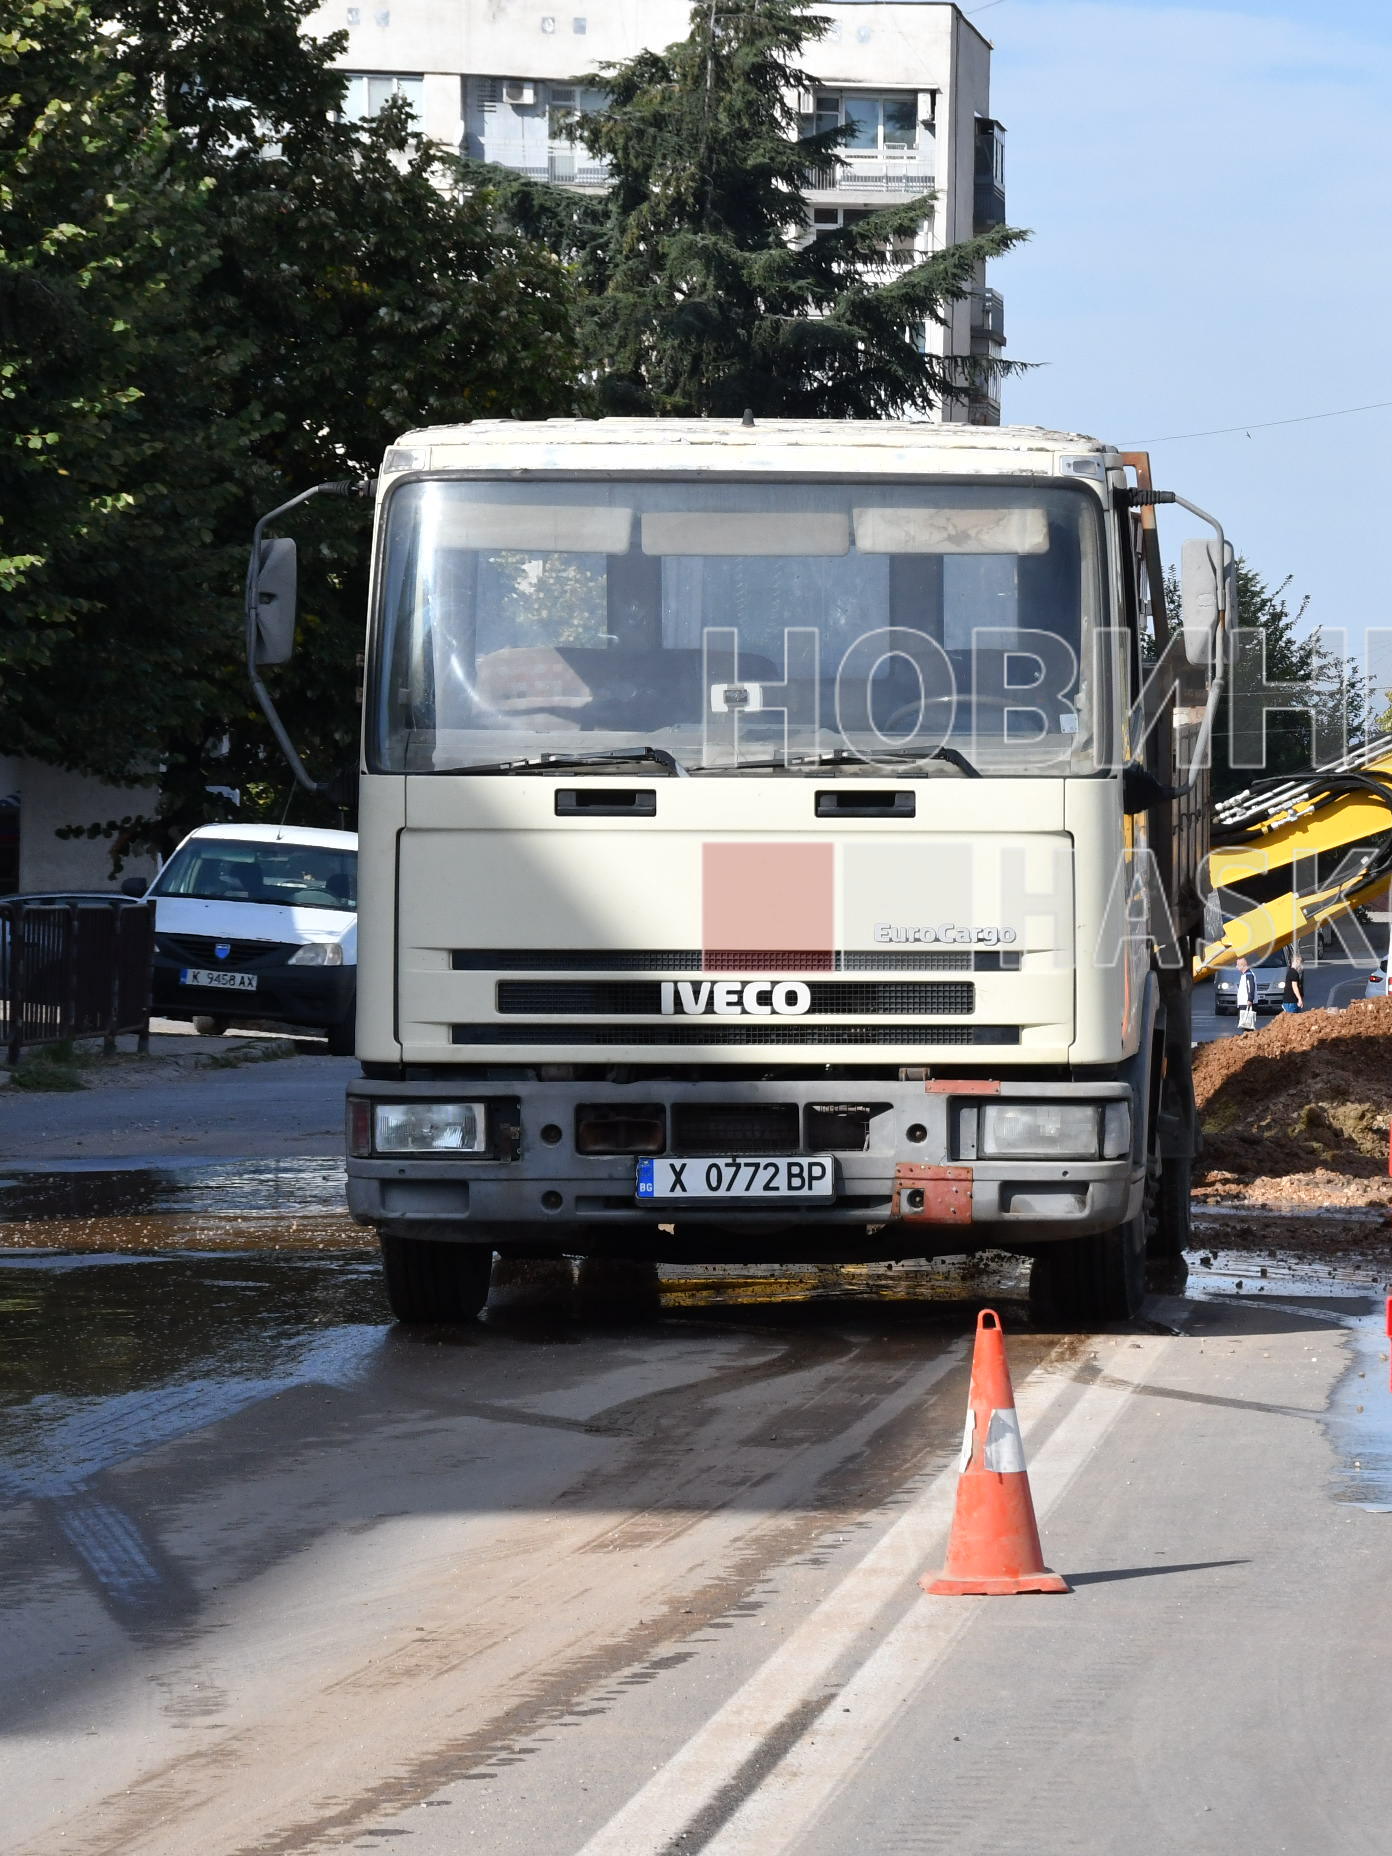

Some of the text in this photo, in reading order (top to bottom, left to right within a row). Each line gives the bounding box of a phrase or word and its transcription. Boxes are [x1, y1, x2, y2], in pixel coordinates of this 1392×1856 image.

[873, 922, 1017, 945] EuroCargo
[660, 981, 812, 1015] IVECO
[705, 1162, 780, 1192] 0772
